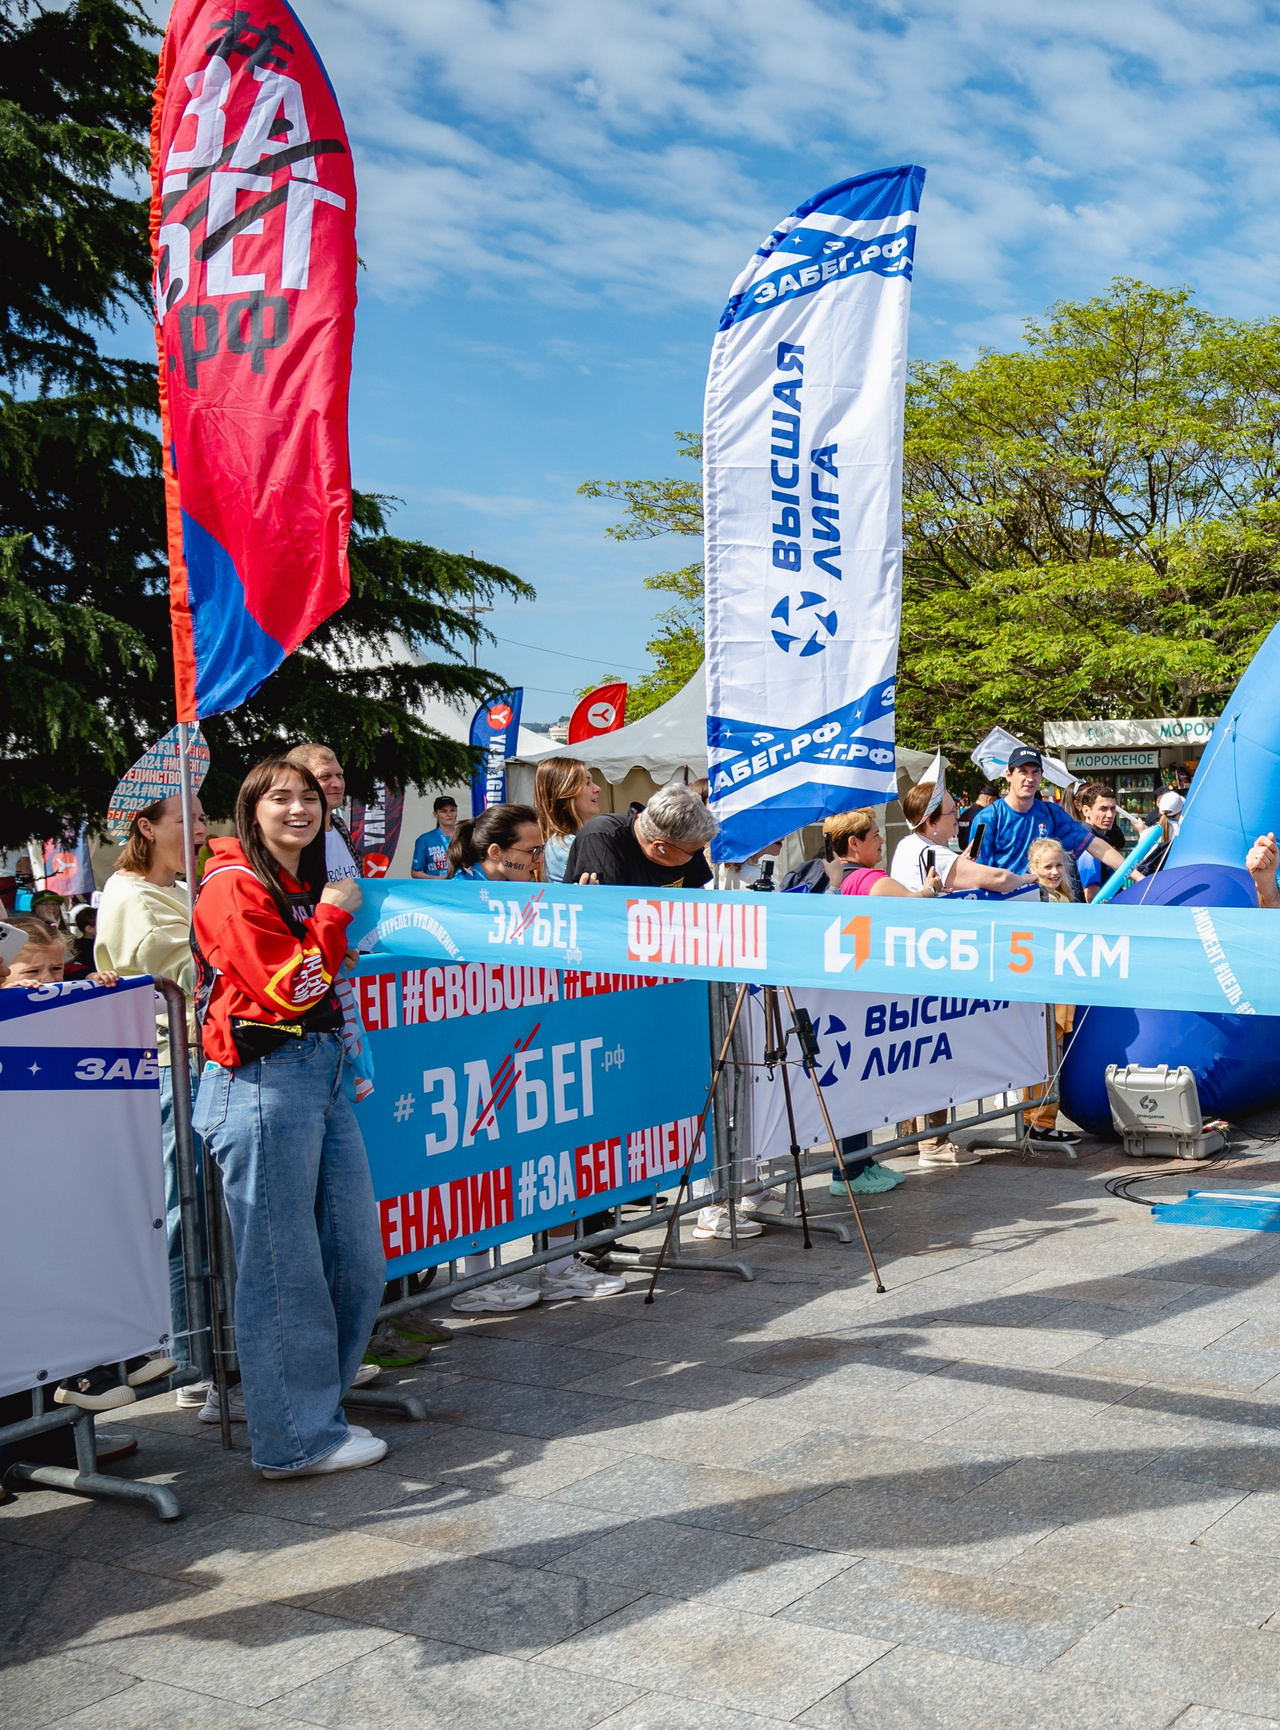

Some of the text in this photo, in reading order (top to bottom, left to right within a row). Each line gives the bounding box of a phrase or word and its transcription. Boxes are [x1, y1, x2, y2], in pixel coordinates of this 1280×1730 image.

[773, 342, 804, 572] ВЫСШАЯ
[811, 444, 842, 580] ЛИГА
[1075, 754, 1154, 767] МОРОЖЕНОЕ
[381, 912, 412, 937] #ТРЕПЕТ
[413, 912, 459, 958] #УДИВЛЕНИЕ
[627, 900, 767, 969] ФИНИШ
[885, 927, 1129, 979] ПСБ 5 КМ
[1191, 907, 1243, 1006] #МОМЕНТ #ЦЕЛЬ
[402, 962, 560, 1026] #СВОБОДА
[860, 1032, 953, 1081] ЛИГА
[379, 1165, 514, 1260] ЕНАЛИН
[518, 1136, 623, 1217] #ЗАБЕГ
